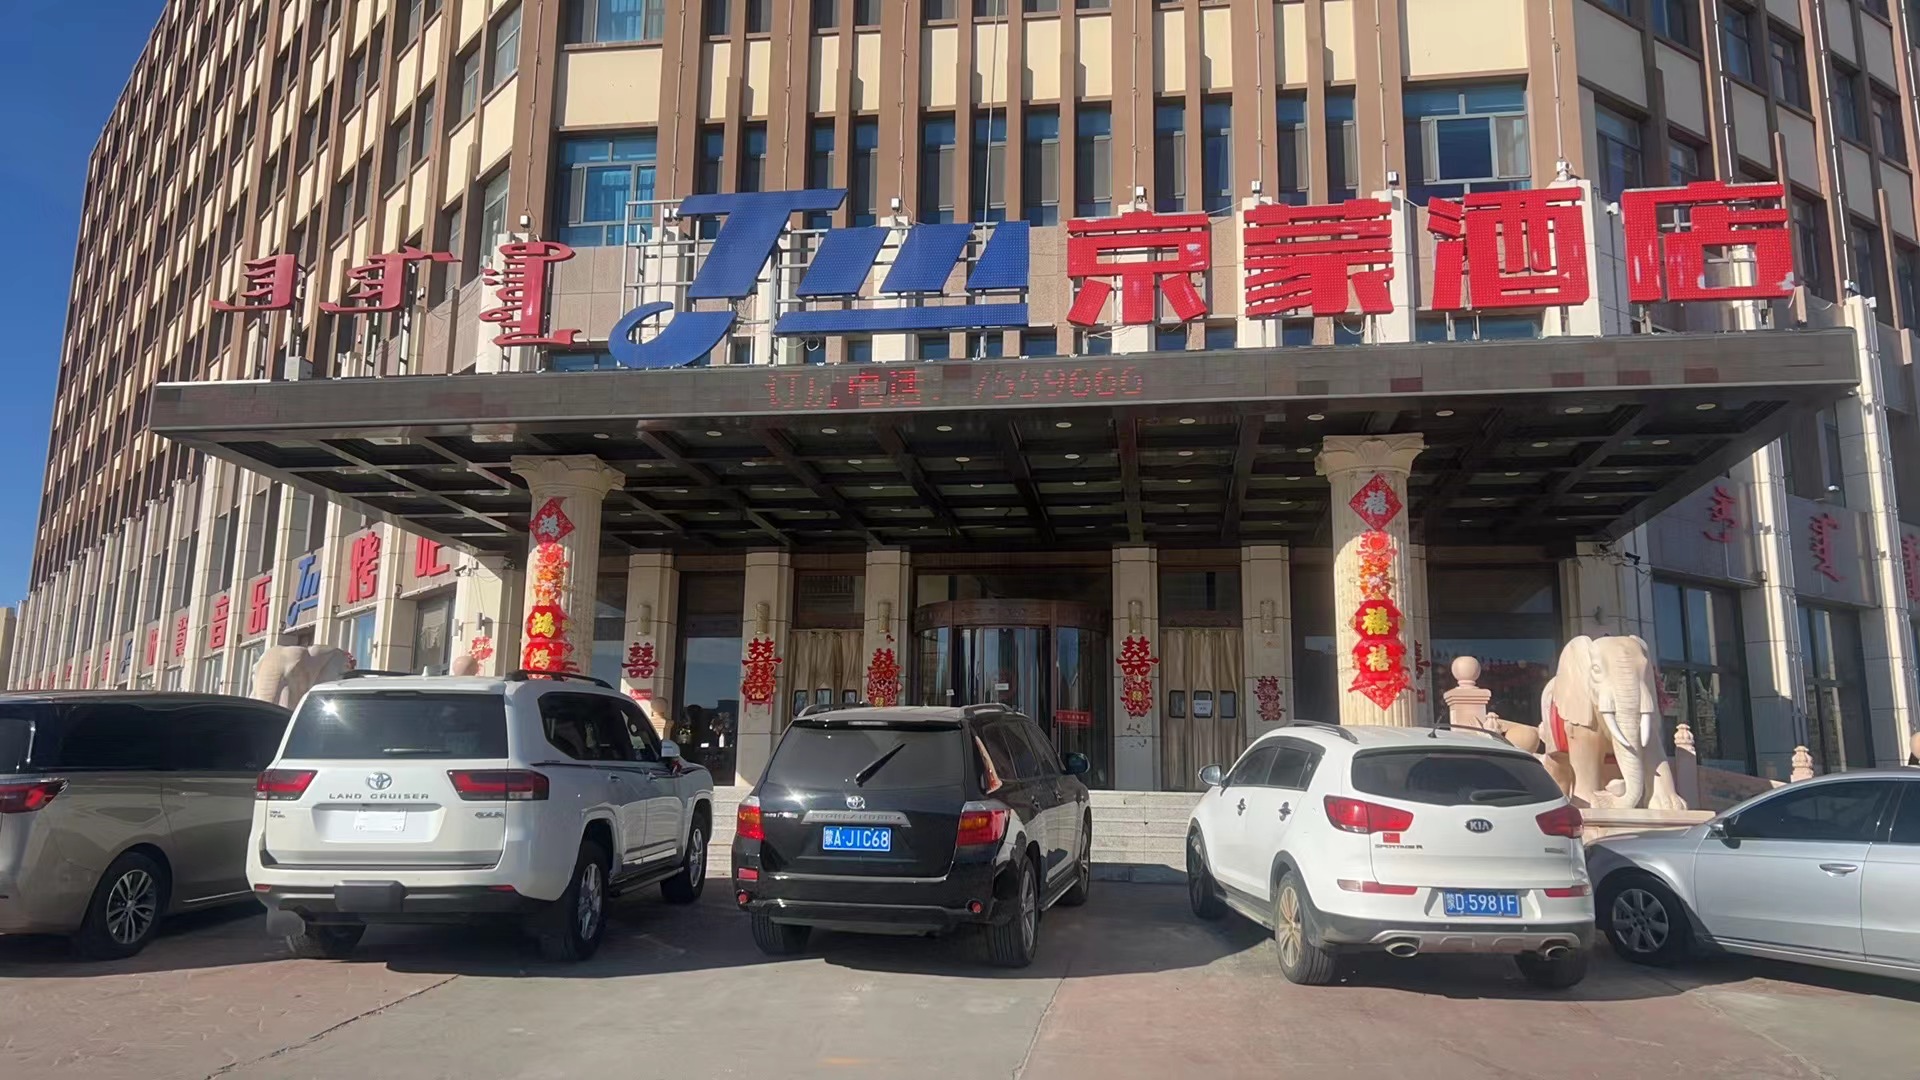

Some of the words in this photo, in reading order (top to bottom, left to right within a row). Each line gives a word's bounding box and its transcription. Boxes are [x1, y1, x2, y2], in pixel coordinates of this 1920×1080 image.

[1066, 179, 1797, 327] 京蒙酒店
[1469, 820, 1490, 831] KIA
